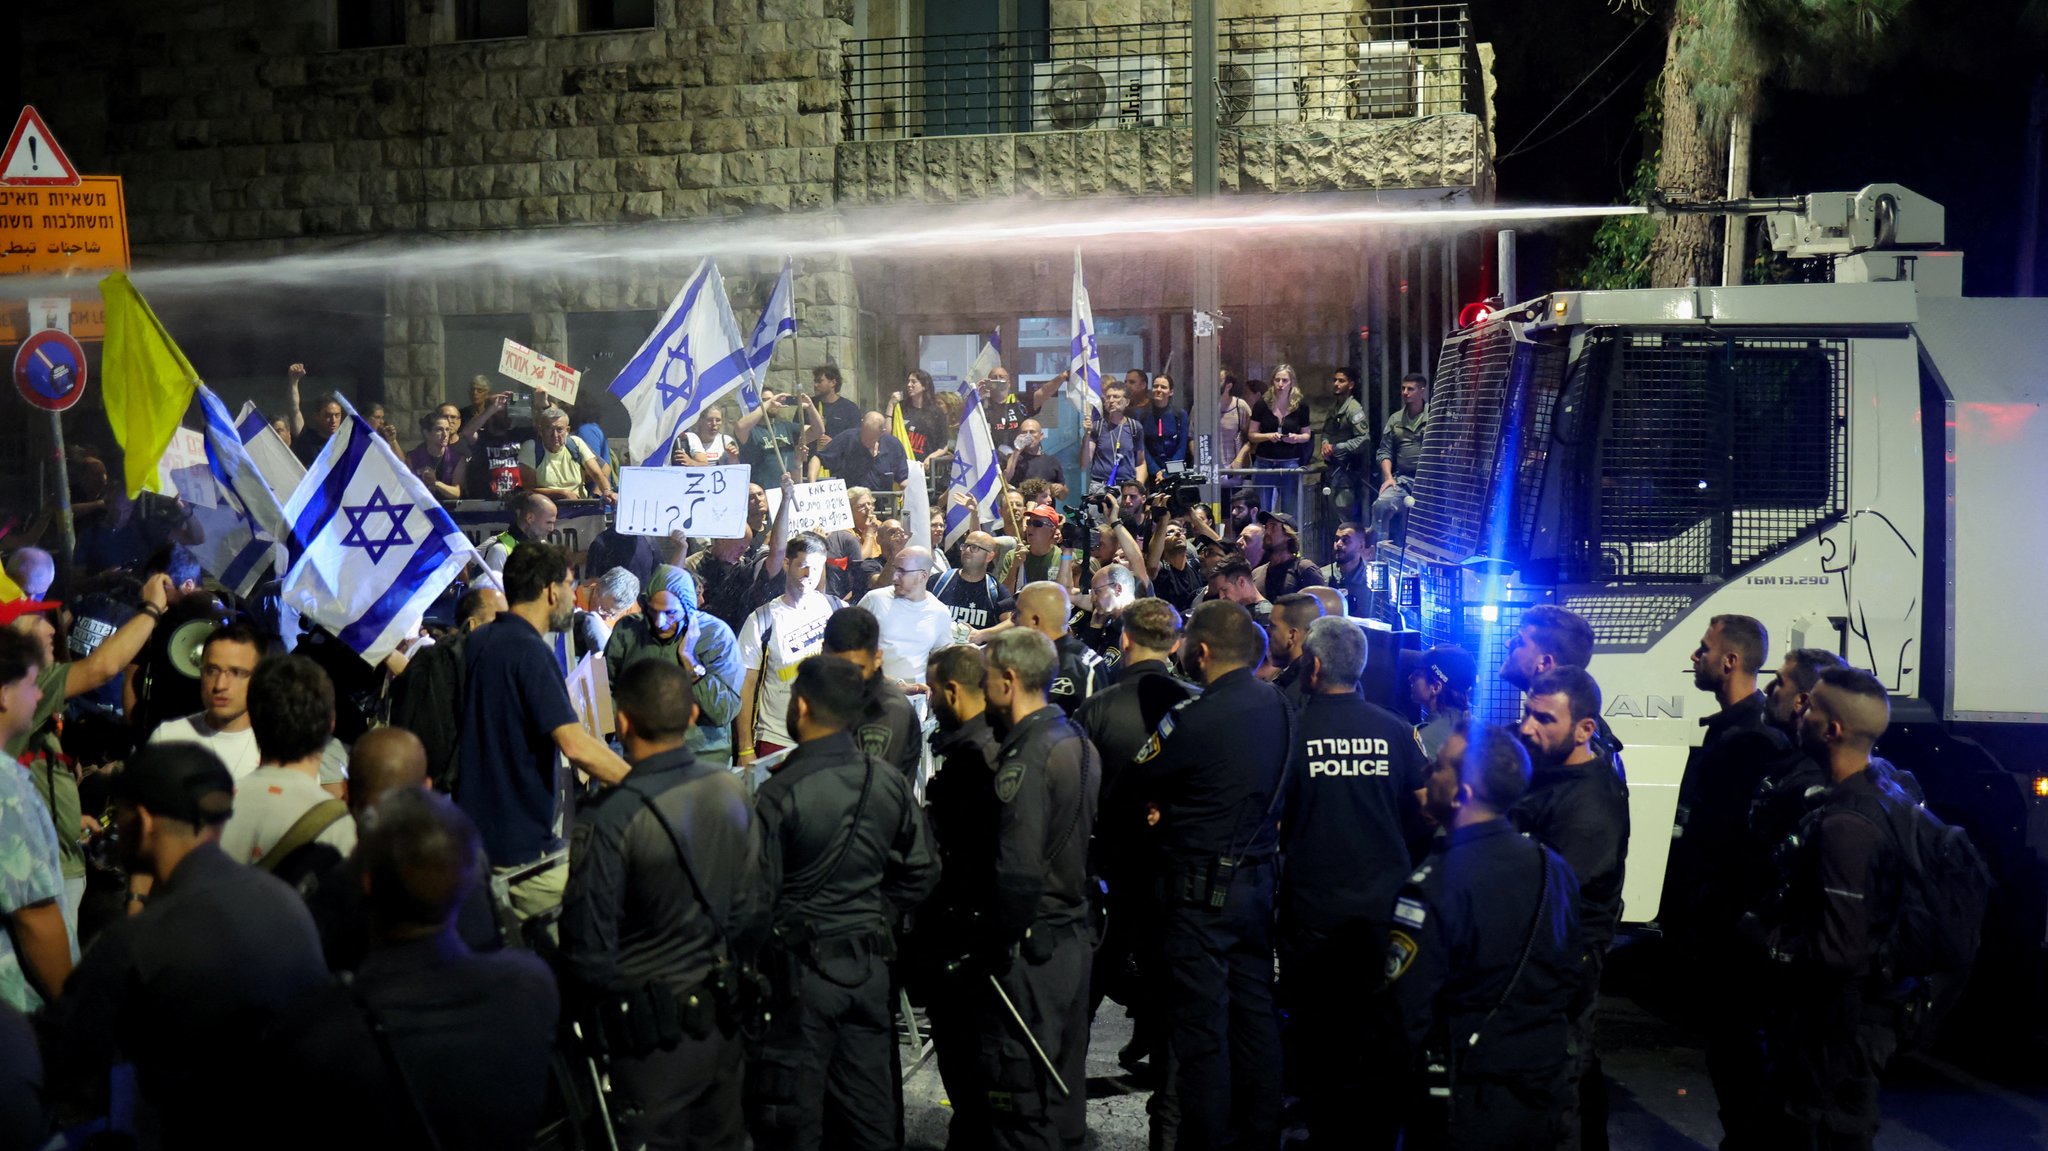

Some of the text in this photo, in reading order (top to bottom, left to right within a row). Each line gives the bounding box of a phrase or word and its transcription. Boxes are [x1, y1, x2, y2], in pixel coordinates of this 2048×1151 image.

[48, 192, 106, 206] משאיות
[43, 213, 114, 229] ומשתלבות
[47, 241, 101, 254] شاحنات
[1746, 576, 1829, 585] TGM 13.290
[1604, 695, 1685, 718] AN
[1306, 738, 1389, 756] משטרה
[1309, 760, 1389, 777] POLICE
